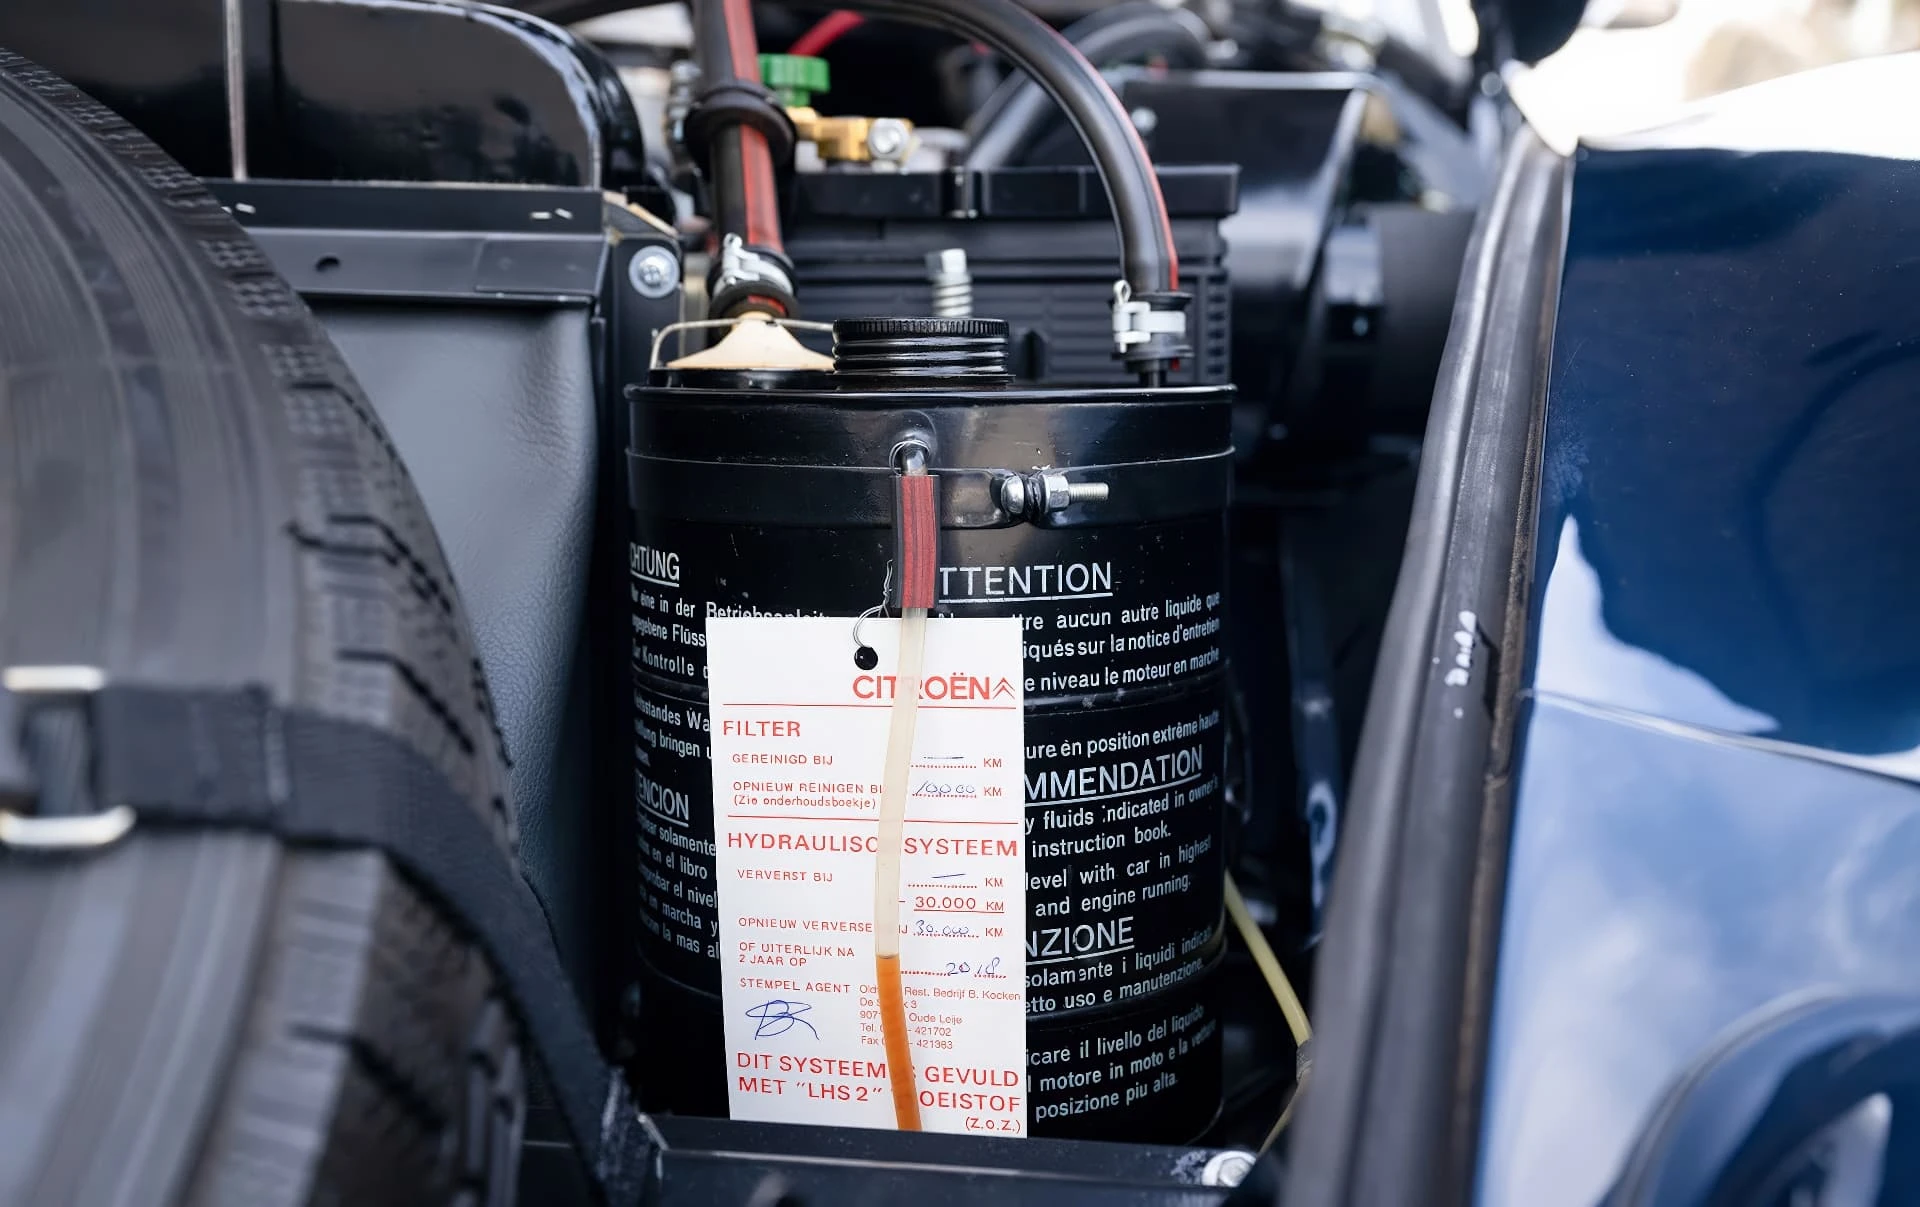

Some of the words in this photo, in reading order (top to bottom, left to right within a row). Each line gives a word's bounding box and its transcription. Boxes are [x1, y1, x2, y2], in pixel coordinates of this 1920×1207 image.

[939, 561, 1112, 596] TTENTION
[659, 594, 669, 613] in
[675, 598, 696, 618] der
[1056, 611, 1111, 629] aucun
[1121, 604, 1159, 624] autre
[1165, 593, 1202, 620] liquide
[672, 623, 706, 647] Flüss
[1023, 639, 1075, 662] iqués
[1077, 640, 1105, 656] sur
[1110, 633, 1125, 653] la
[1128, 629, 1170, 650] notice
[1172, 616, 1221, 644] d'entretien
[642, 645, 695, 677] Kontrolle
[1024, 678, 1035, 692] e
[1041, 672, 1100, 692] niveau
[1105, 666, 1119, 686] le
[1122, 662, 1172, 684] moteur
[1173, 659, 1187, 675] en
[852, 672, 990, 700] CITOËN
[723, 720, 802, 737] FILTER
[659, 729, 701, 758] bringen
[1024, 744, 1057, 759] ure
[1087, 731, 1150, 756] position
[732, 754, 808, 764] GEREINIGD
[813, 755, 834, 766] BIJ
[983, 758, 1003, 768] KM
[1024, 744, 1203, 800] MMENDATION
[733, 781, 794, 793] OPNIEUW
[800, 783, 865, 794] REINIGEN
[870, 785, 884, 794] BI
[983, 786, 1003, 797] KM
[734, 794, 758, 806] (Zie
[763, 796, 877, 810] onderhoudsboekje)
[1024, 816, 1035, 835] y
[1043, 807, 1094, 830] fluids
[1174, 790, 1185, 808] in
[659, 826, 717, 856] solamente
[728, 832, 878, 853] HYDRAULISC
[904, 837, 1018, 857] SYSTEEM
[1032, 831, 1126, 858] instruction
[1134, 820, 1172, 844] book.
[665, 851, 675, 869] el
[679, 855, 708, 880] libro
[737, 869, 808, 881] VERVERST
[813, 872, 833, 882] BIJ
[985, 877, 1003, 888] KM
[1025, 868, 1067, 891] level
[1080, 862, 1115, 885] with
[1126, 859, 1150, 877] car
[1159, 852, 1171, 870] in
[673, 880, 683, 899] el
[687, 886, 717, 909] nivel
[915, 896, 977, 910] 30.000
[986, 901, 1005, 911] KM
[1035, 896, 1070, 916] and
[1081, 889, 1136, 912] engine
[1142, 874, 1191, 901] running.
[662, 902, 702, 929] marcha
[738, 917, 797, 929] OPNIEUW
[802, 920, 873, 933] VERVERSE
[898, 924, 908, 934] IJ
[985, 927, 1003, 937] KM
[676, 934, 700, 953] mas
[707, 941, 719, 960] al
[739, 942, 756, 951] OF
[761, 943, 833, 957] UITERLIJK
[837, 947, 855, 957] NA
[1025, 916, 1134, 958] NZIONE
[739, 954, 746, 963] 2
[750, 955, 785, 966] JAAR
[789, 957, 807, 967] OP
[1122, 957, 1127, 974] i
[1135, 942, 1175, 971] liquidi
[739, 977, 800, 991] STEMPEL
[805, 982, 851, 993] AGENT
[859, 984, 880, 994] Old
[904, 986, 930, 997] Rest.
[933, 987, 965, 1000] Bedrijf
[968, 989, 979, 999] B.
[1025, 998, 1056, 1014] etto
[1064, 992, 1096, 1010] uso
[1103, 989, 1113, 1002] e
[908, 1012, 936, 1023] Oude
[861, 1035, 879, 1045] Fax
[1026, 1048, 1071, 1067] icare
[1079, 1039, 1089, 1059] il
[1097, 1029, 1142, 1056] livello
[1147, 1019, 1167, 1043] del
[737, 1052, 772, 1070] DIT
[779, 1055, 886, 1079] SYSTEEM
[924, 1066, 1019, 1087] GEVULD
[1040, 1068, 1102, 1092] motore
[1109, 1062, 1124, 1080] in
[1130, 1052, 1164, 1075] moto
[1168, 1047, 1176, 1061] e
[1179, 1038, 1188, 1056] la
[738, 1076, 786, 1095] MET
[919, 1090, 1021, 1112] OEISTOF
[1035, 1092, 1120, 1123] posizione
[1126, 1079, 1148, 1106] piu
